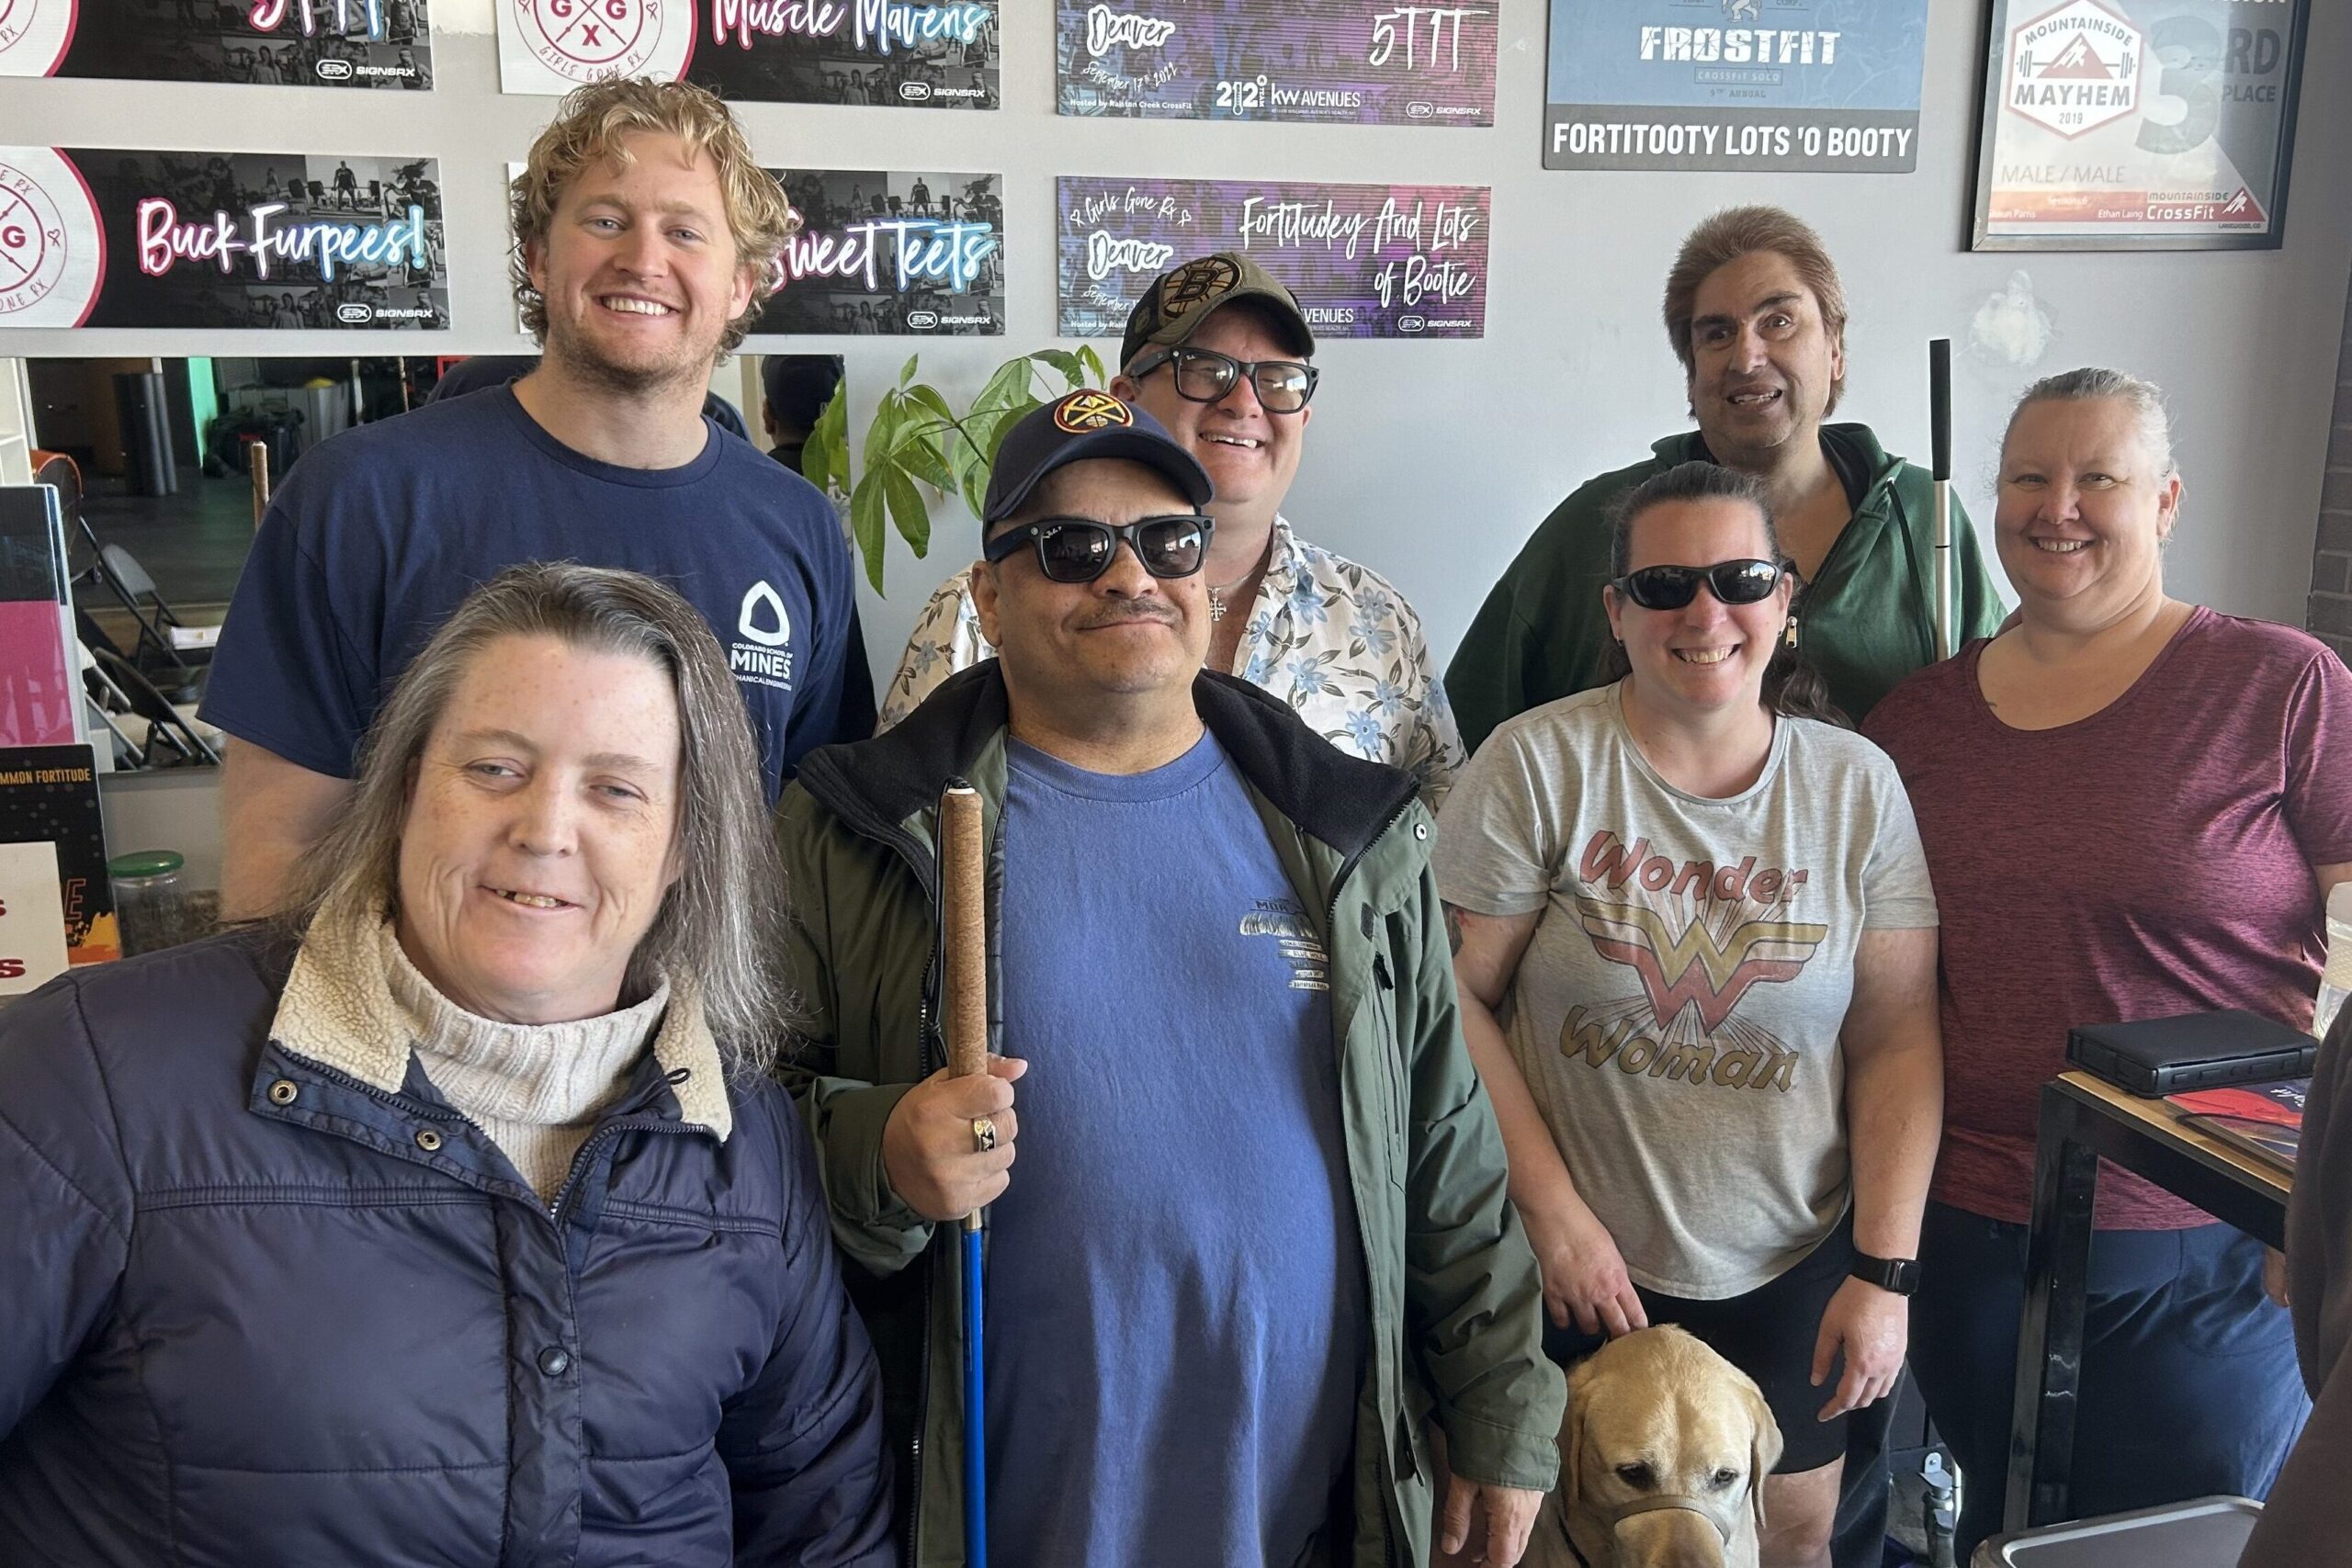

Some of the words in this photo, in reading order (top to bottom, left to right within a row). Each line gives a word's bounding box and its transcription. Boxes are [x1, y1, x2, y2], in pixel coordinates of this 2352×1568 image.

[582, 24, 602, 47] X
[713, 0, 847, 50] Muscle
[854, 0, 990, 54] Mavens
[1089, 6, 1174, 54] Denver
[2025, 17, 2132, 46] MOUNTAINSIDE
[1640, 26, 1841, 64] FROSTFIT
[356, 65, 415, 77] SIGNSRX
[538, 46, 579, 76] GIRLS
[628, 50, 644, 69] RX
[1082, 62, 1130, 90] September
[1697, 71, 1747, 81] CROSSFIT
[1751, 72, 1780, 81] SOLO
[933, 87, 985, 98] SIGNSRX
[1069, 98, 1097, 107] Hosted
[1098, 99, 1108, 109] by
[1138, 101, 1161, 109] Creek
[1271, 83, 1300, 105] kw
[1301, 90, 1361, 107] AVENUES
[2015, 84, 2130, 107] MAYHEM
[2222, 85, 2277, 102] PLACE
[1436, 107, 1482, 116] SIGNSRX
[2059, 112, 2084, 125] 2019
[1553, 122, 1720, 155] FORTITOOTY
[1724, 125, 1791, 156] LOTS
[1826, 128, 1913, 157] BOOTY
[2001, 165, 2055, 184] MALE
[2073, 165, 2126, 184] MALE
[15, 177, 35, 197] RX
[1085, 190, 1120, 223] Girls
[1124, 186, 1158, 214] Gone
[2098, 209, 2120, 219] Ethan
[2121, 209, 2143, 221] Laing
[2146, 205, 2215, 220] CrossFit
[2, 225, 27, 249] G
[137, 198, 245, 276] Buck
[249, 201, 427, 282] Furpees!
[1238, 197, 1370, 260] Fortitudey
[1373, 197, 1423, 254] And
[1431, 201, 1479, 252] Lots
[879, 219, 996, 292] Teets
[1090, 231, 1172, 278] Denver
[30, 279, 49, 297] RX
[1171, 266, 1222, 302] B
[1374, 261, 1398, 309] of
[1403, 255, 1476, 307] Bootie
[1082, 284, 1129, 311] September
[375, 309, 434, 319] SIGNSRX
[940, 315, 991, 325] SIGNSRX
[1300, 307, 1354, 323] VENUES
[1427, 319, 1472, 328] SIGNSRX
[1098, 321, 1108, 331] by
[731, 642, 766, 653] COLORADO
[730, 649, 792, 680] MINES
[35, 768, 91, 783] FORTITUDE
[1580, 829, 1808, 904] Wonder
[1560, 1005, 1799, 1092] Woman
